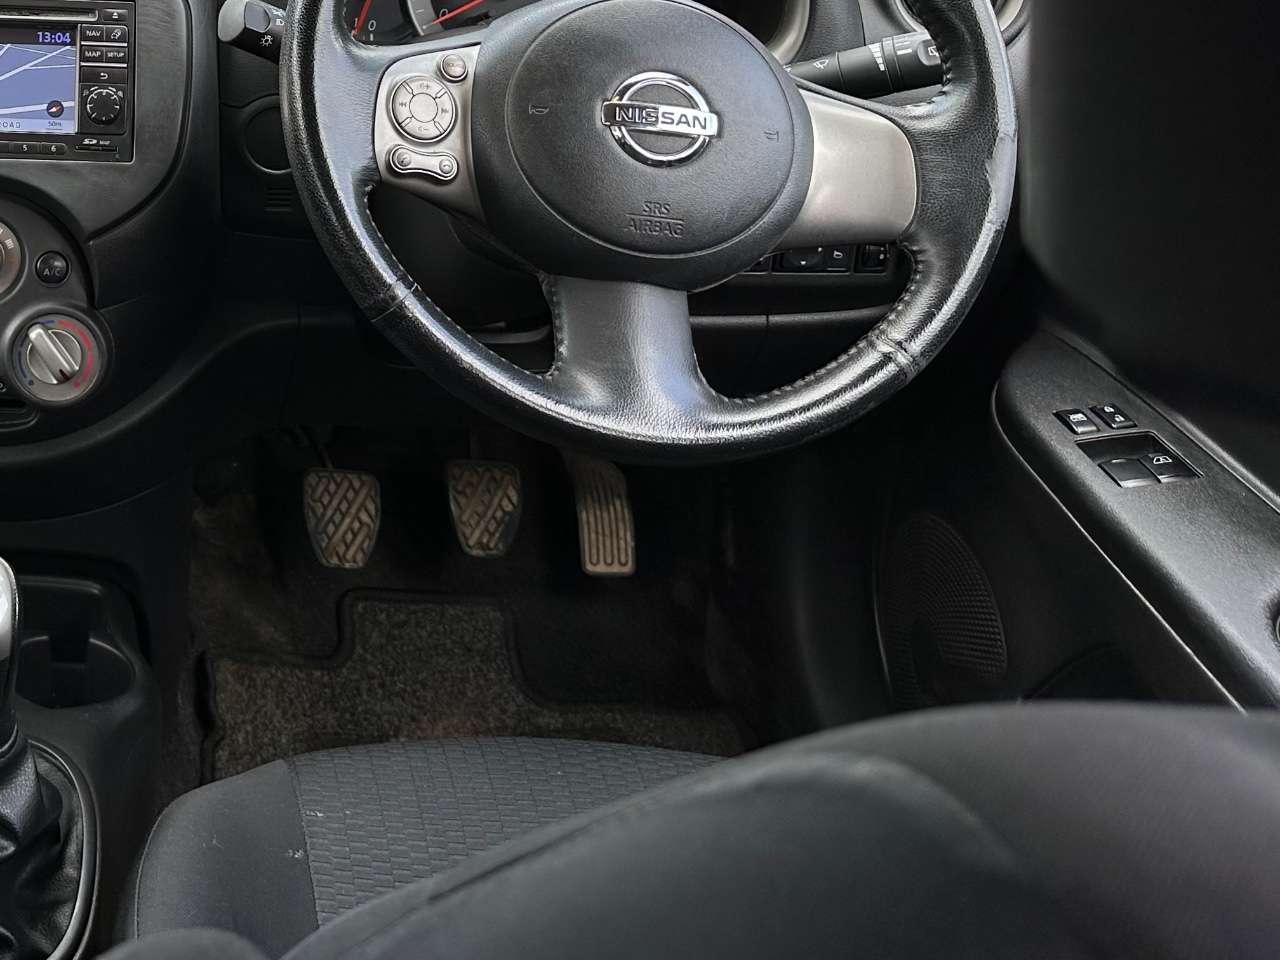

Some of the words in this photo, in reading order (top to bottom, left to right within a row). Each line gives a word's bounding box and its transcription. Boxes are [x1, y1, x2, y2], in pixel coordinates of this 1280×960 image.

[36, 31, 72, 43] 13:04
[85, 50, 101, 58] MAP
[615, 106, 707, 130] NISSAN
[642, 200, 671, 216] SRS
[624, 218, 686, 238] AIRBAG
[43, 268, 61, 277] A/C
